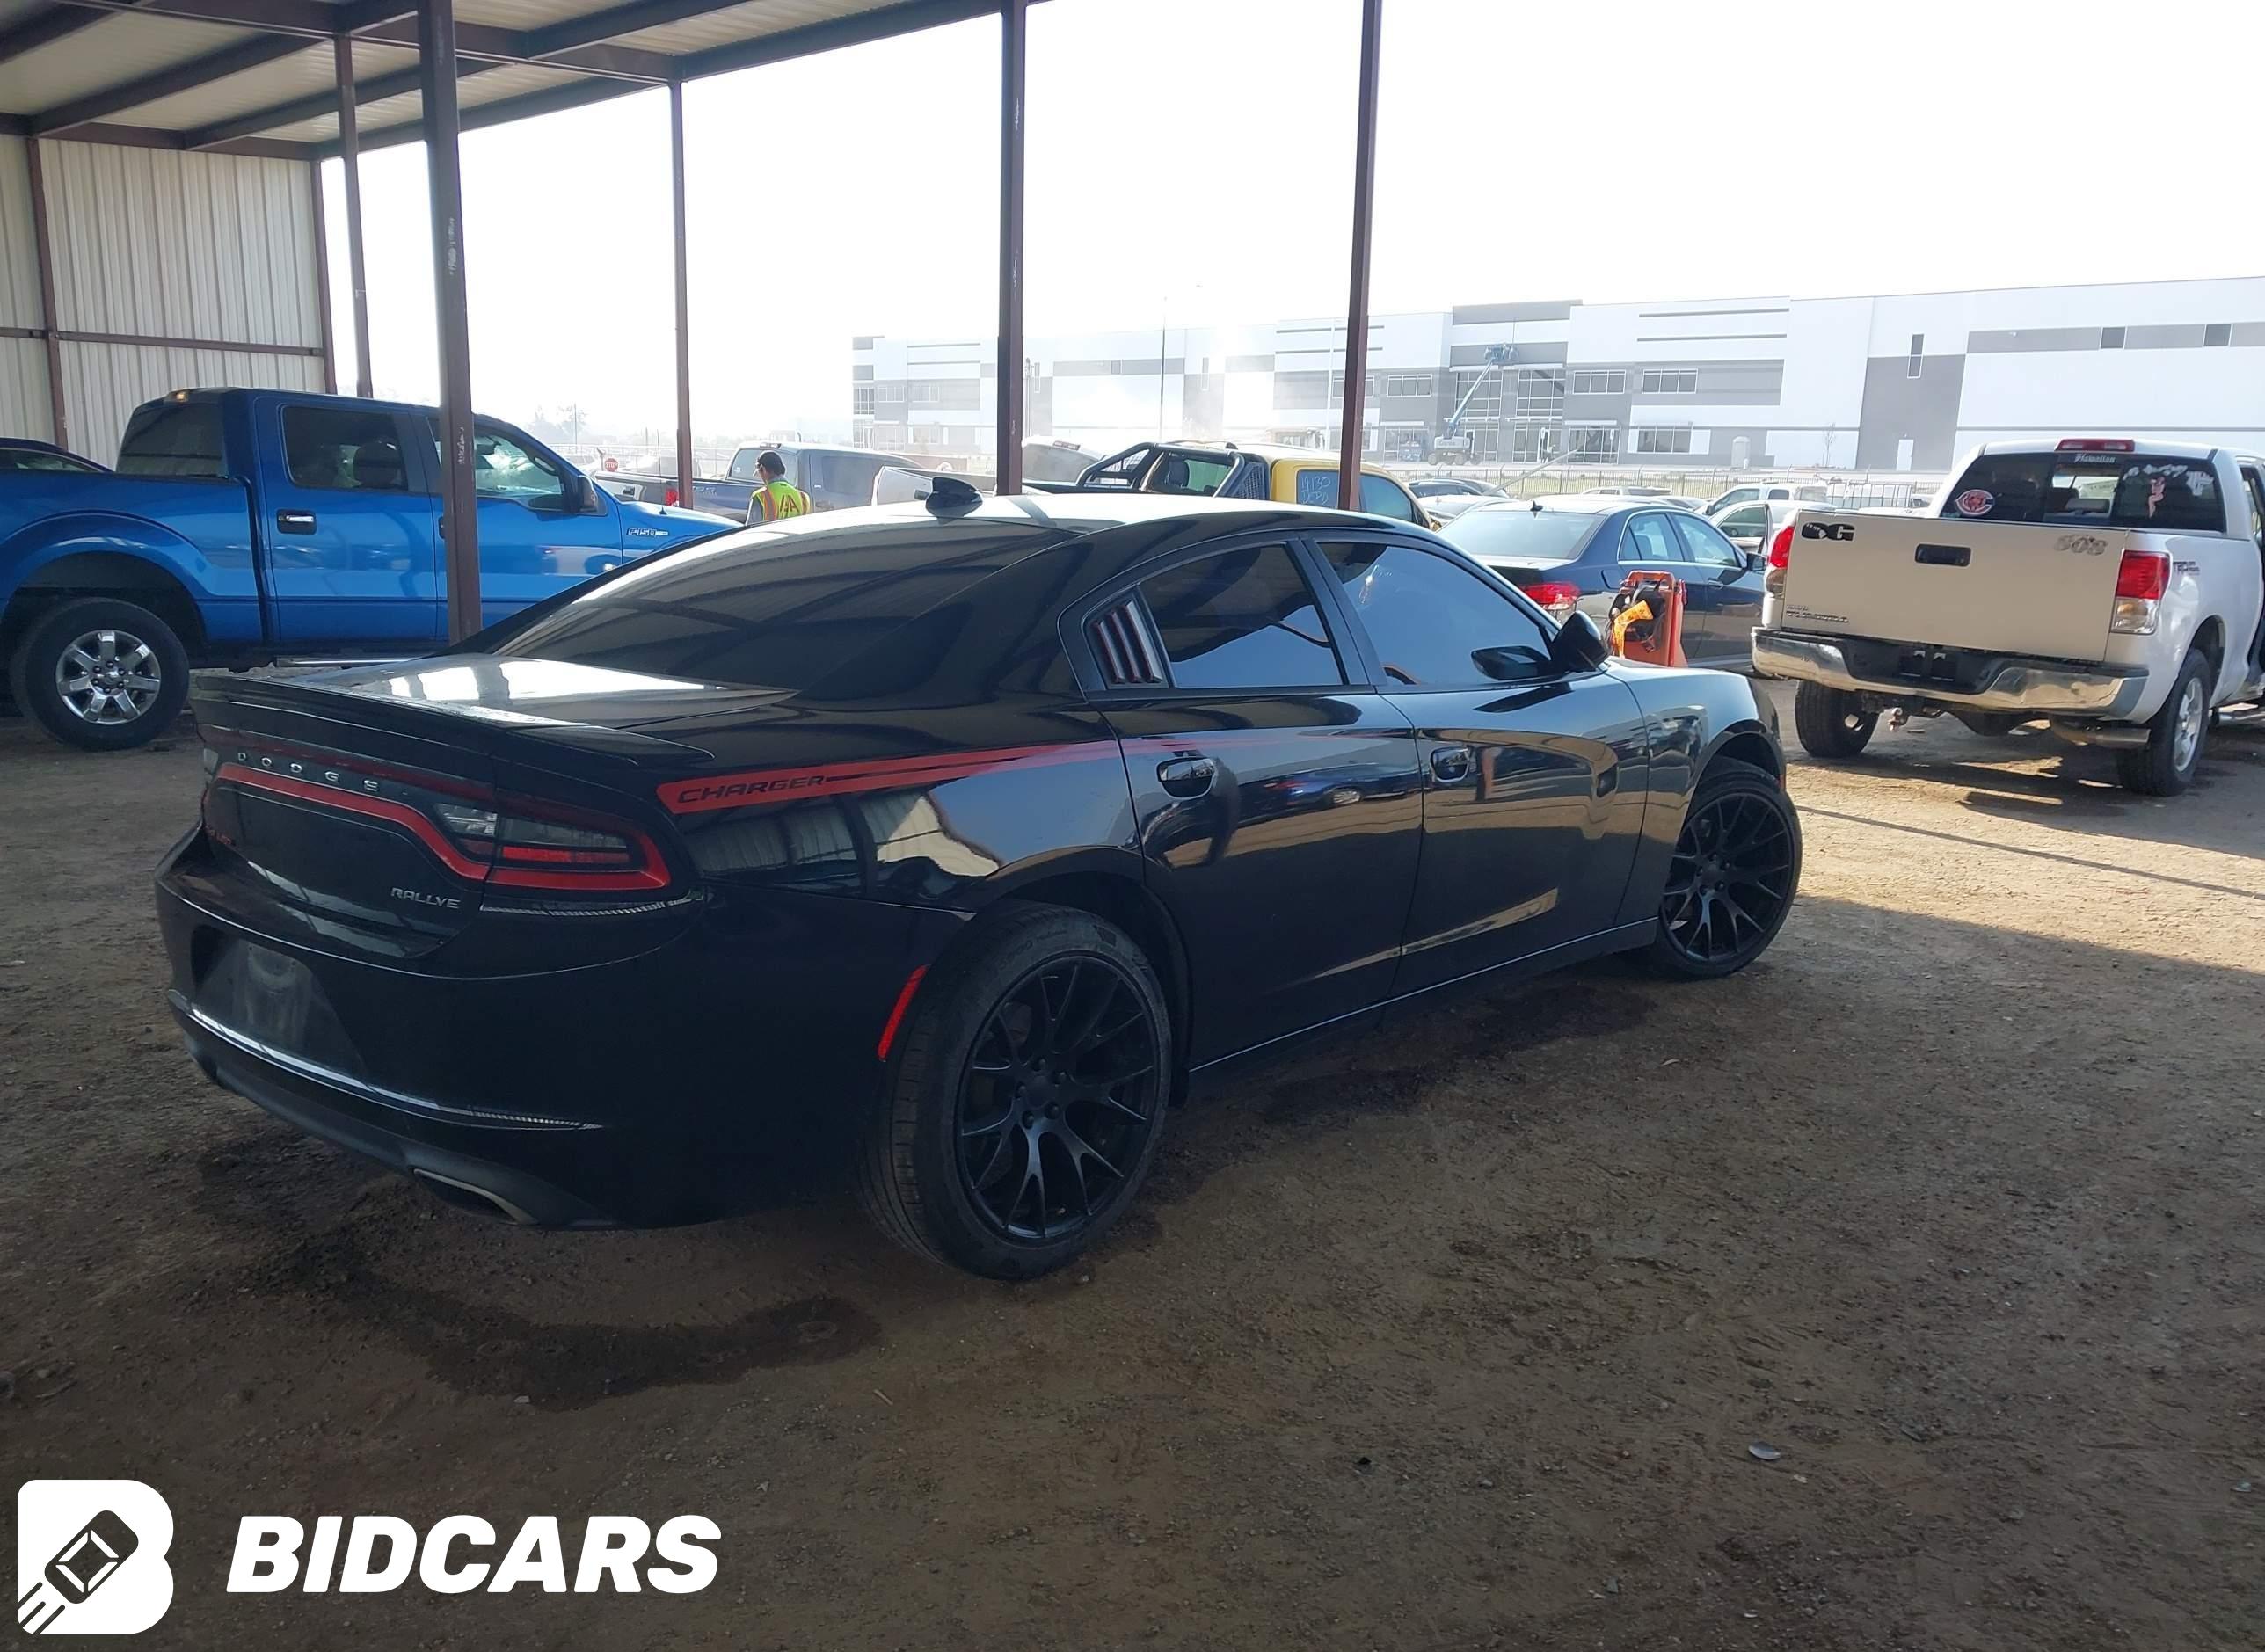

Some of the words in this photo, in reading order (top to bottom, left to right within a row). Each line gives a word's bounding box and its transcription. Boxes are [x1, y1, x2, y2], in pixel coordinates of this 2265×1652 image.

[237, 752, 378, 792] DODGE
[678, 775, 826, 804] CHARGER
[390, 887, 461, 909] RALLYE
